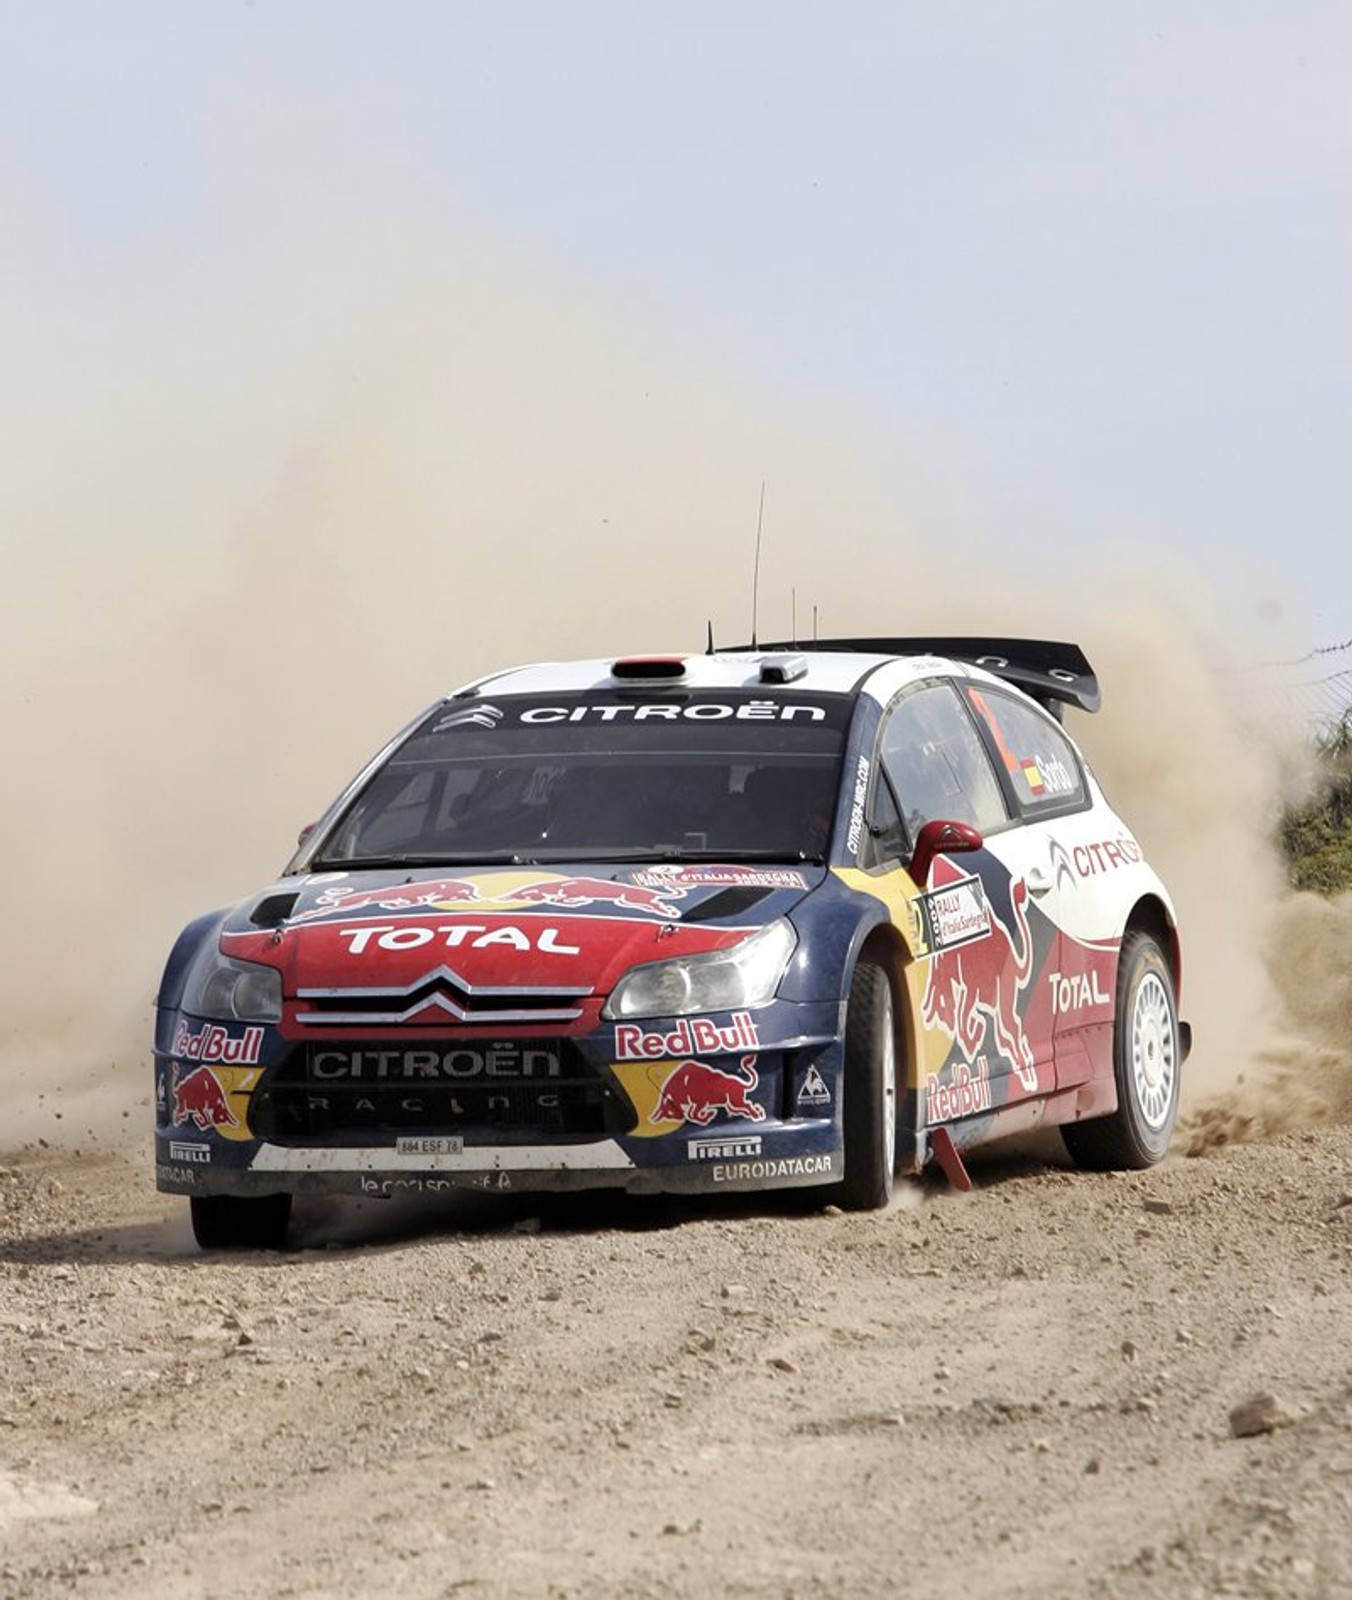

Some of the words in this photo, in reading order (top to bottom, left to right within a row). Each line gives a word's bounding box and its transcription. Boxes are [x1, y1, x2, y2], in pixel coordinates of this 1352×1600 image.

[935, 893, 961, 916] RALLY
[339, 926, 580, 956] TOTAL
[1049, 971, 1110, 1015] TOTAL
[202, 1026, 265, 1064] Bull
[615, 1019, 691, 1060] Red
[690, 1012, 760, 1051] Bull
[926, 1065, 962, 1124] Red
[957, 1054, 992, 1118] Bull
[169, 1141, 211, 1163] PIRELLI
[687, 1135, 762, 1160] PIRELLI
[712, 1155, 833, 1183] EURODATACAR
